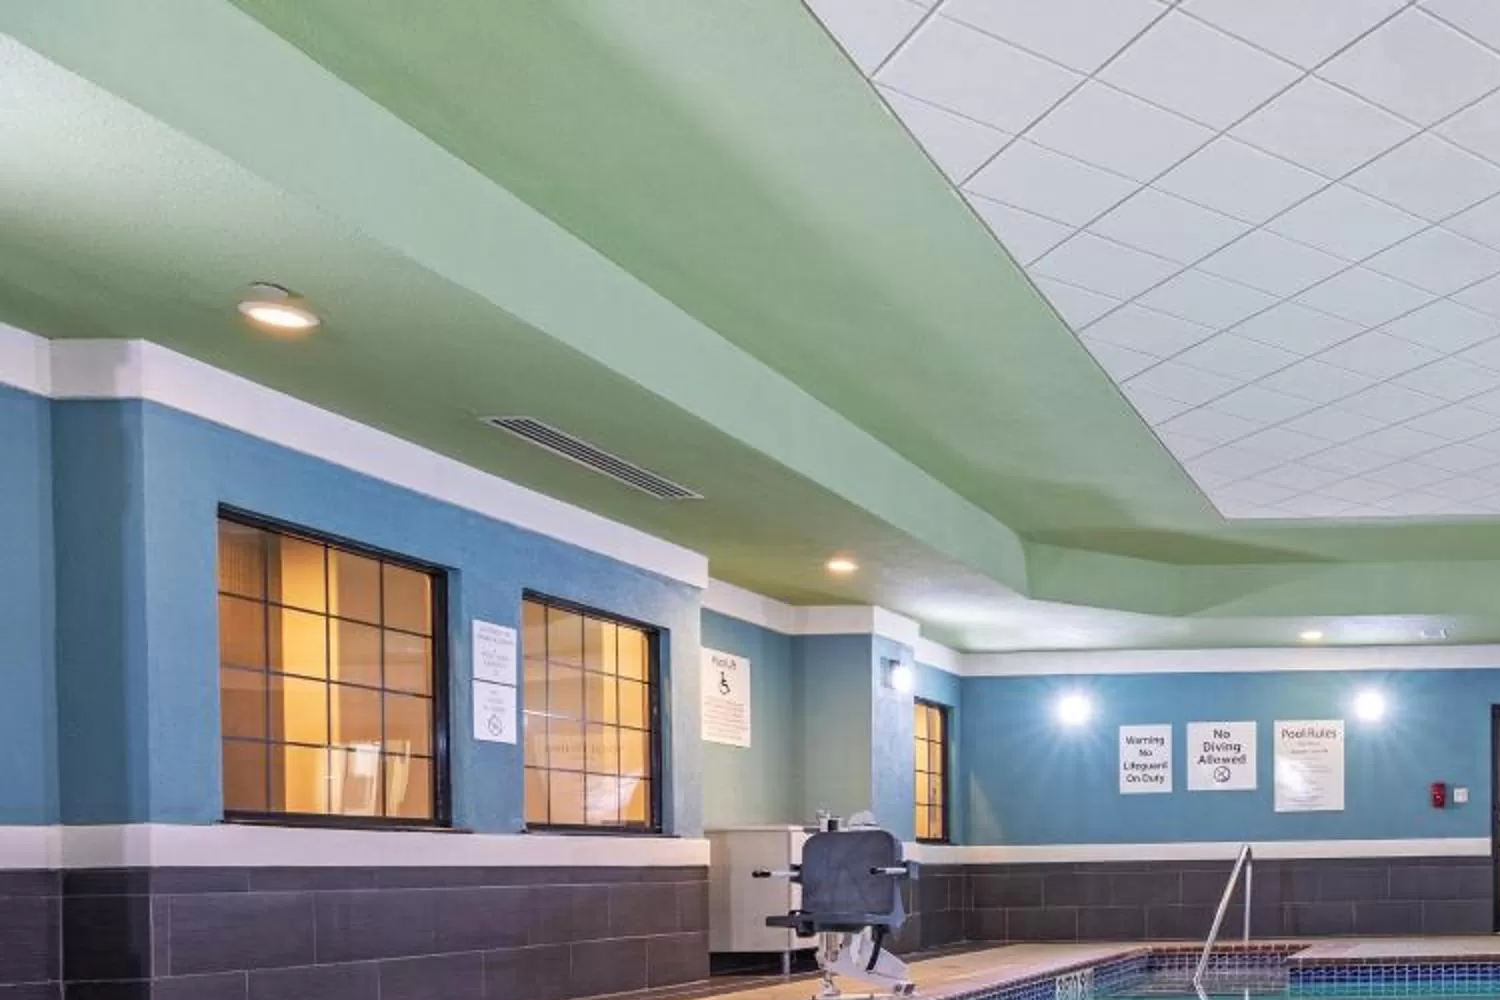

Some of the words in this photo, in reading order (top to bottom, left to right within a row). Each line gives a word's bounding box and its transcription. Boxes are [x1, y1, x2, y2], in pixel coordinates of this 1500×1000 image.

[1213, 729, 1231, 739] No
[1282, 728, 1305, 738] Pool
[1307, 728, 1337, 738] Rules
[1126, 736, 1165, 746] Warning
[1203, 741, 1241, 753] Diving
[1139, 749, 1153, 757] No
[1197, 754, 1246, 764] Allowed
[1124, 761, 1168, 771] Lifeguard
[1126, 774, 1140, 783] On
[1142, 774, 1165, 784] Duty
